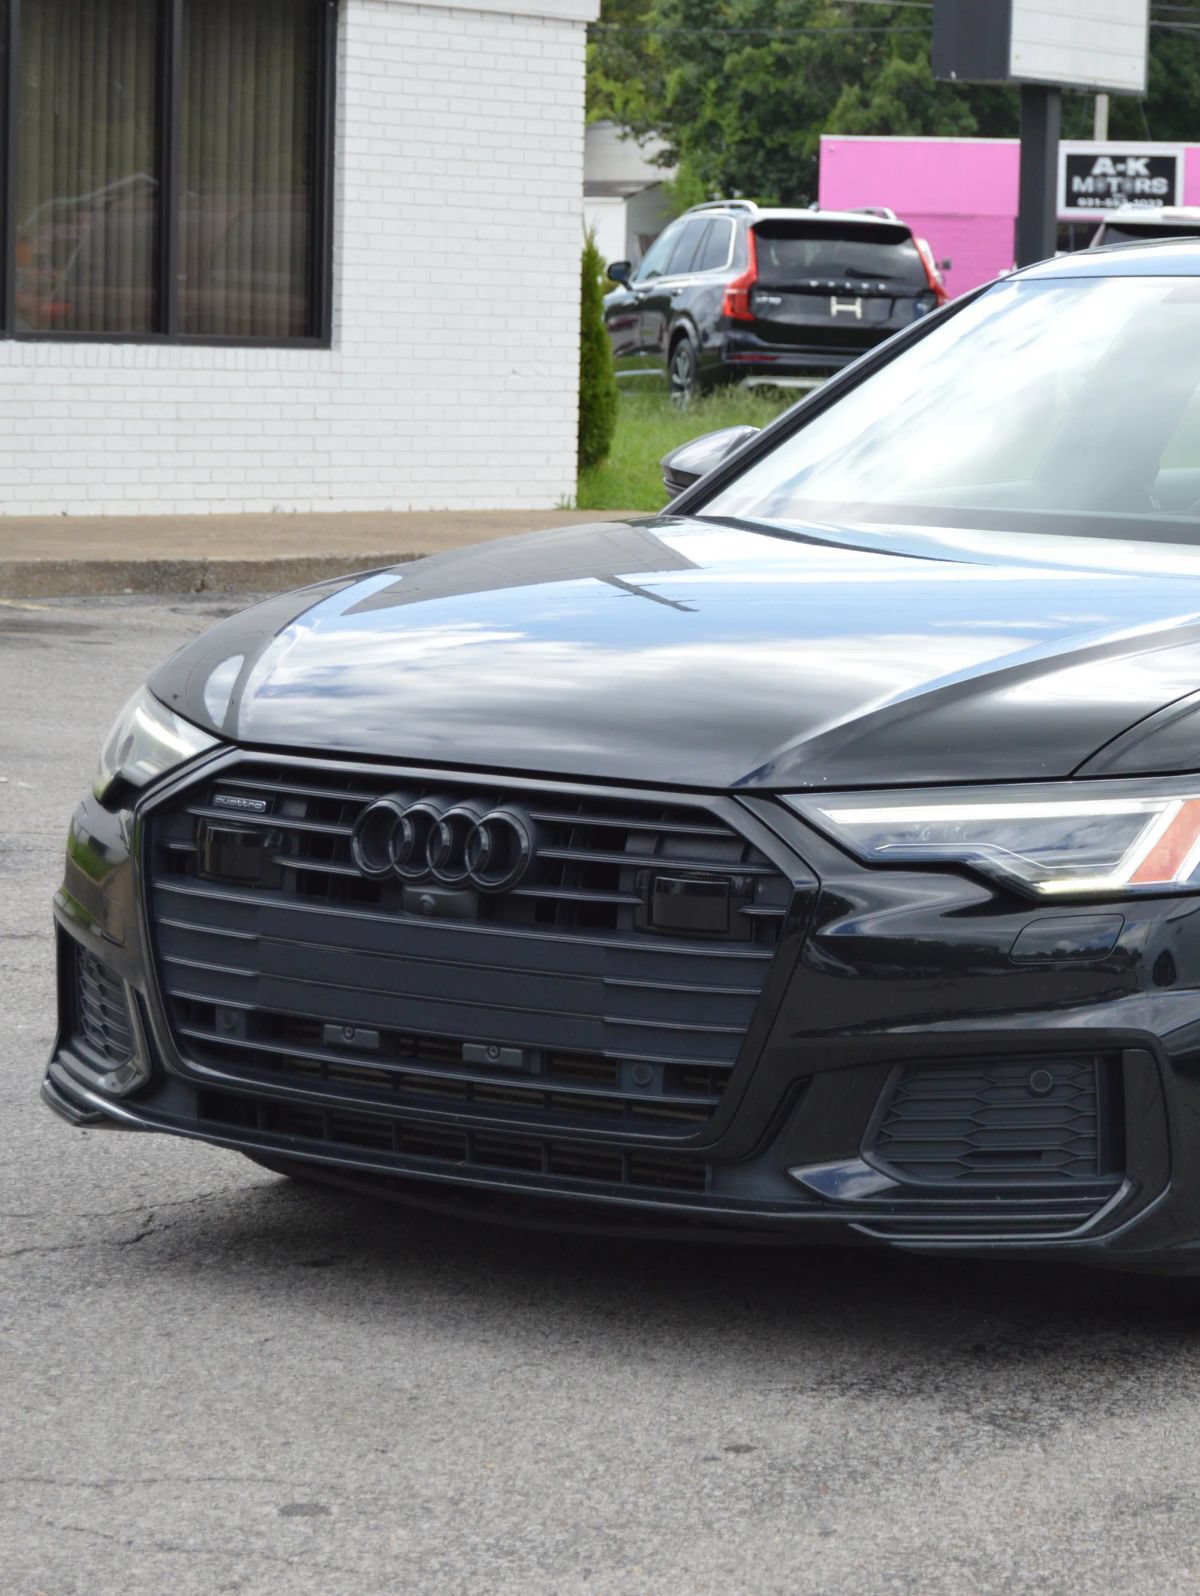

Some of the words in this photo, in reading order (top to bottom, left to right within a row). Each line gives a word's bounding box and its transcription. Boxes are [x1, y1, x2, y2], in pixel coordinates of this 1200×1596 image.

[1091, 156, 1150, 176] A-K
[1071, 175, 1169, 194] MOTORS
[214, 796, 264, 810] quattro
